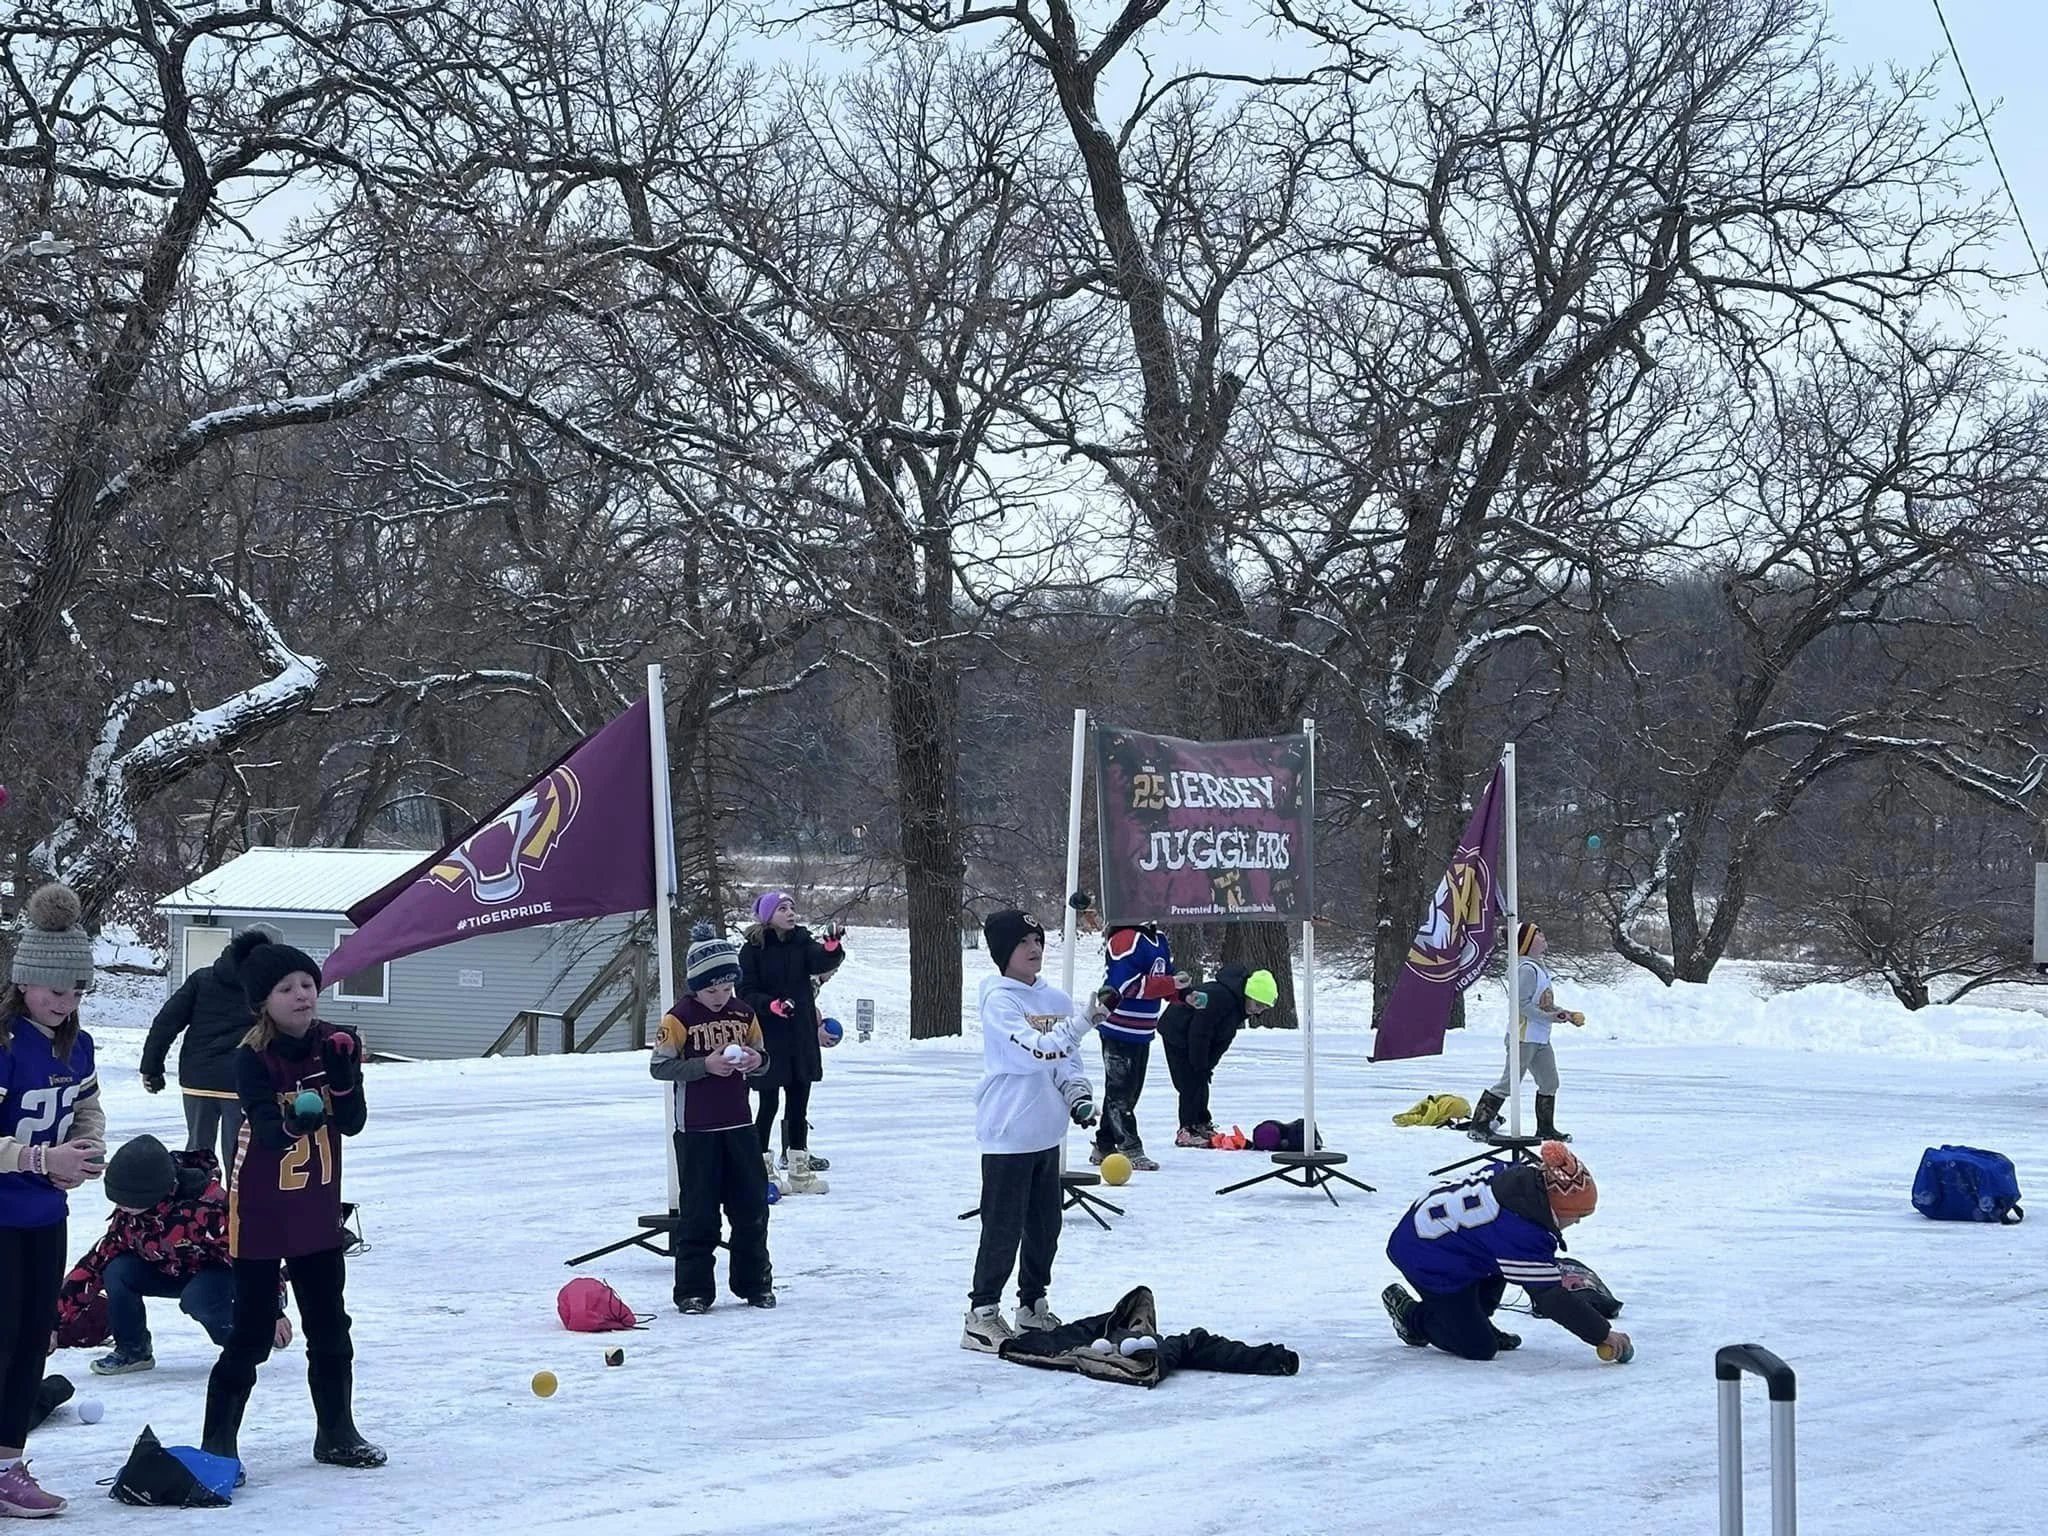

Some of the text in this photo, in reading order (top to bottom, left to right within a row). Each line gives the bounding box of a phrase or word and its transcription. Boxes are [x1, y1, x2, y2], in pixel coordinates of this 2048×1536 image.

[1165, 771, 1276, 809] JERSEY
[1139, 827, 1291, 871] JUGGLERS
[456, 901, 553, 931] #TIGERPRIDE
[279, 1125, 332, 1190] 21
